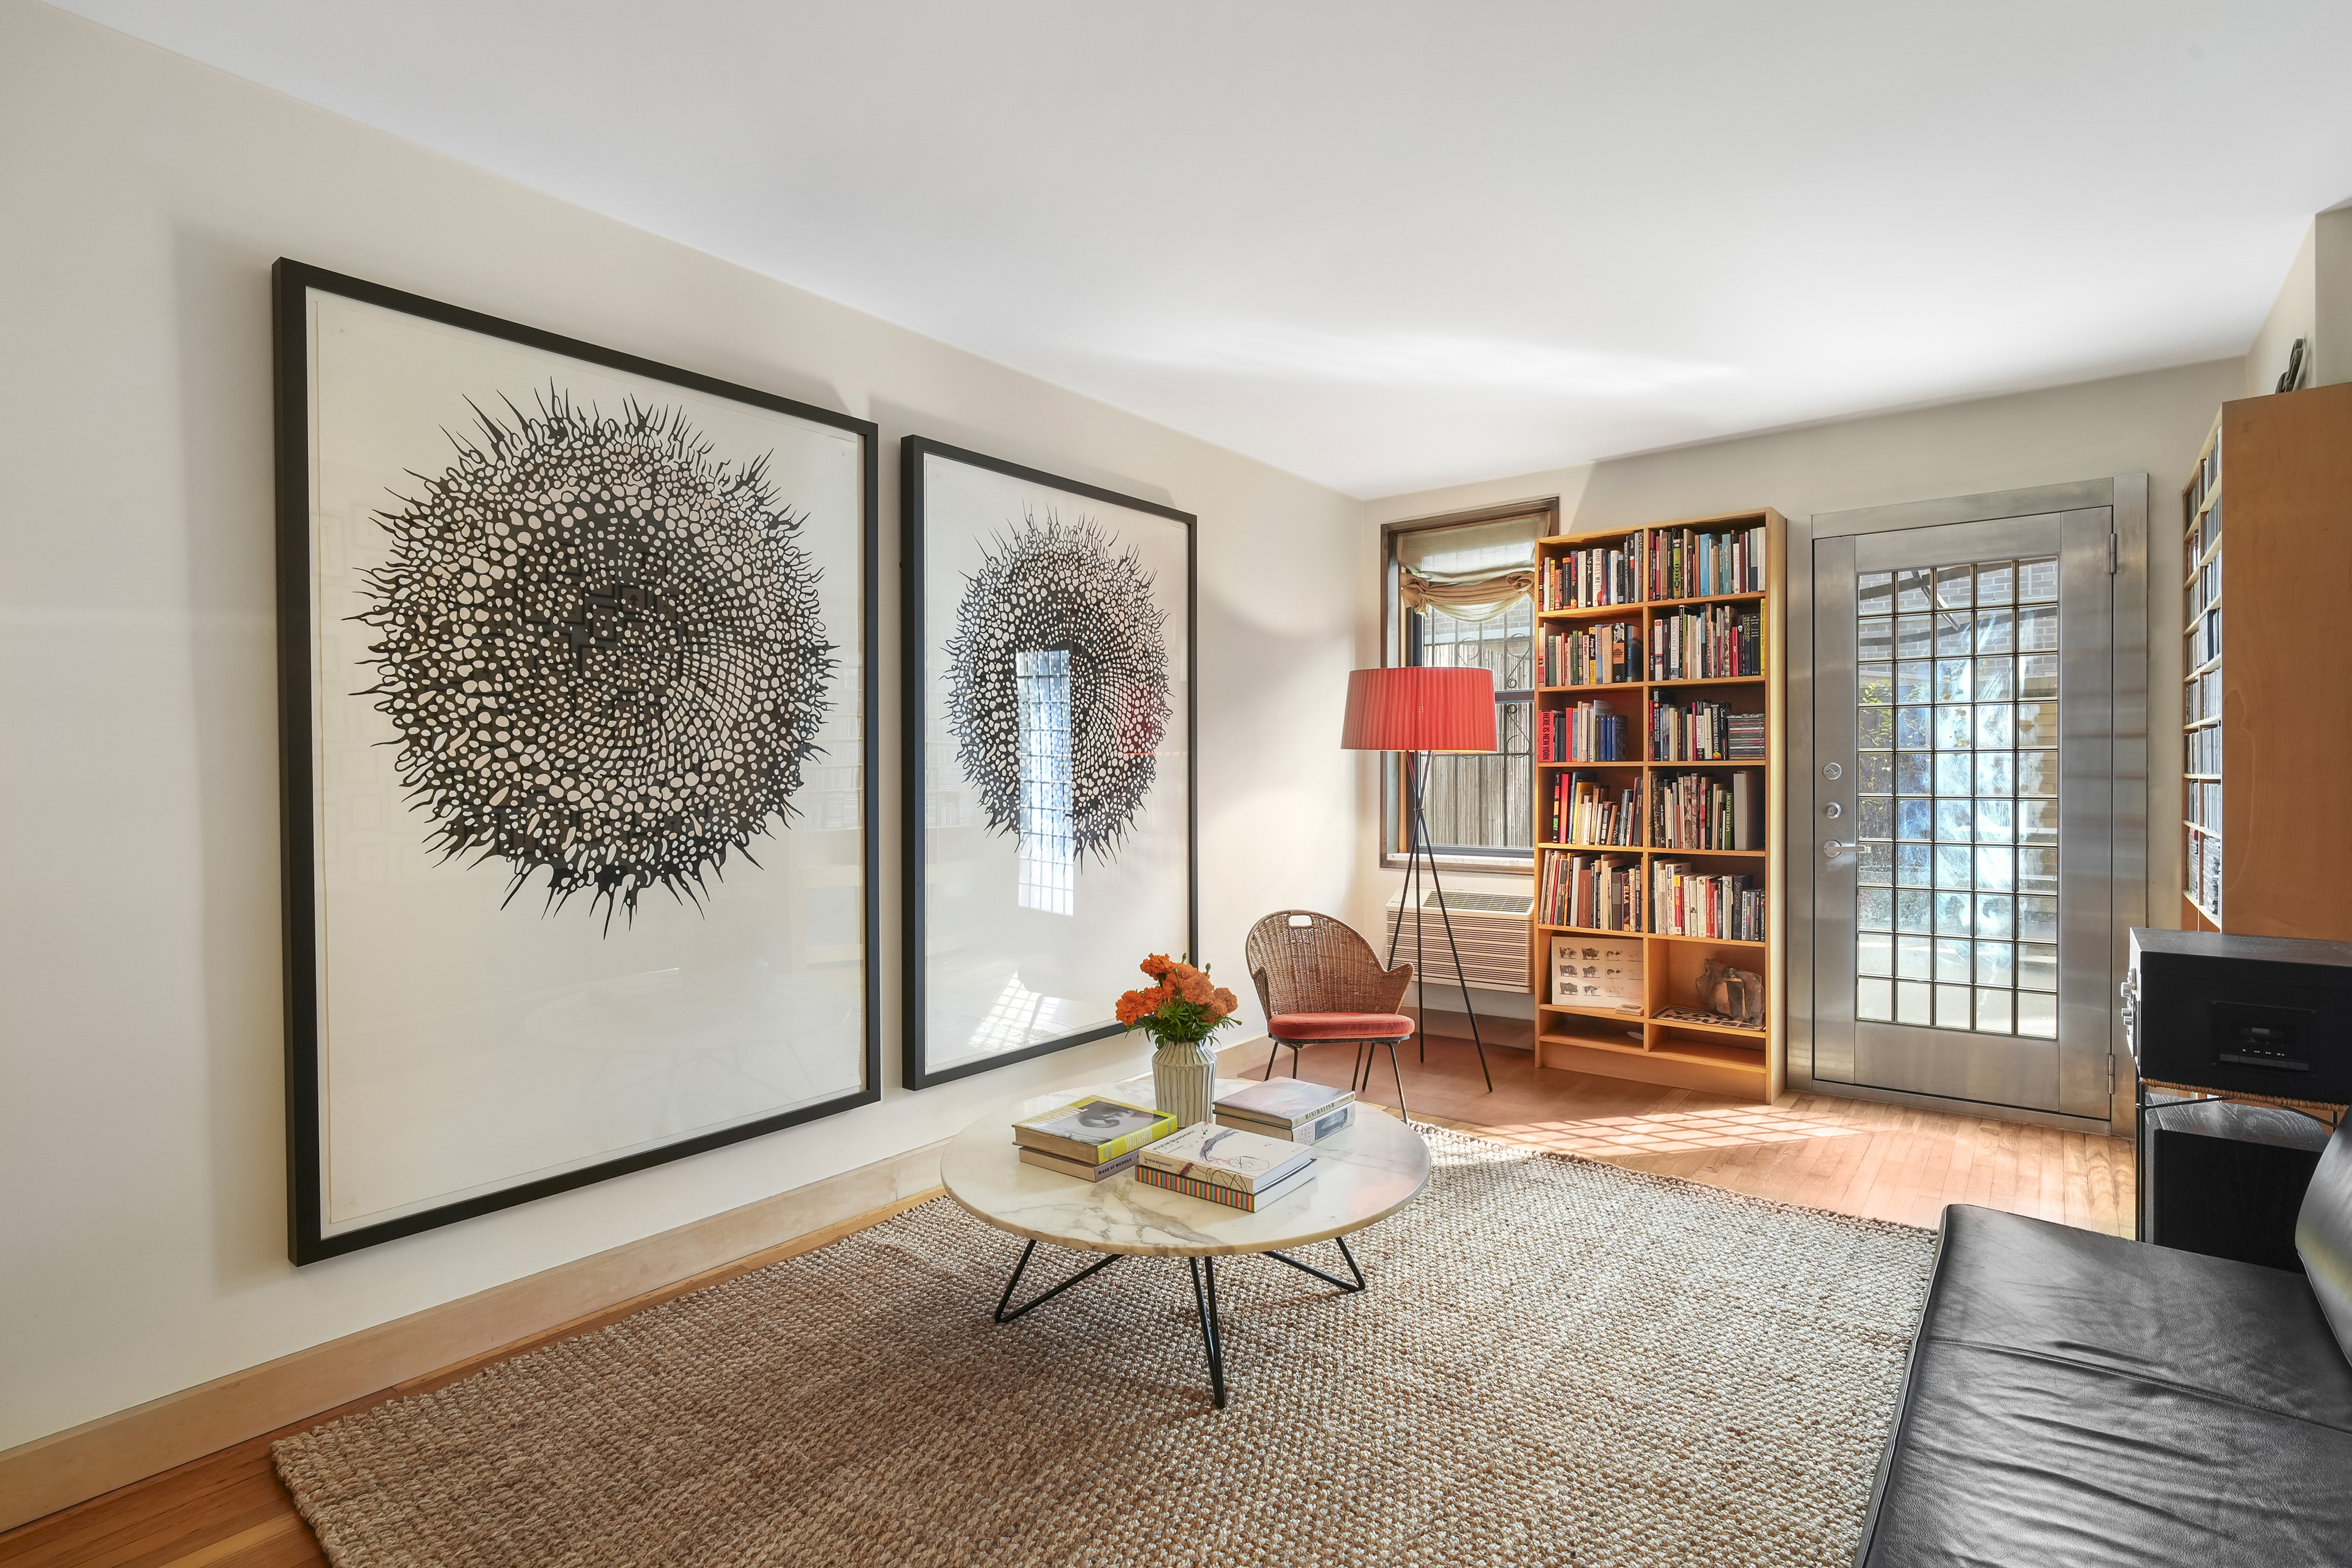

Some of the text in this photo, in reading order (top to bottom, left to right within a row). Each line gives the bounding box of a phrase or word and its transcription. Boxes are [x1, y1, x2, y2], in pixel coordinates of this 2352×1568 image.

[1723, 879, 1731, 889] Q
[1020, 1106, 1089, 1127] WARHOL
[1305, 1102, 1336, 1120] MINIMALISM
[1124, 1126, 1154, 1153] WARHOL
[1152, 1142, 1169, 1150] MUSEUM
[1169, 1130, 1196, 1143] BRANDHORST
[1098, 1167, 1110, 1175] MASK
[1116, 1158, 1132, 1168] MEDUSA
